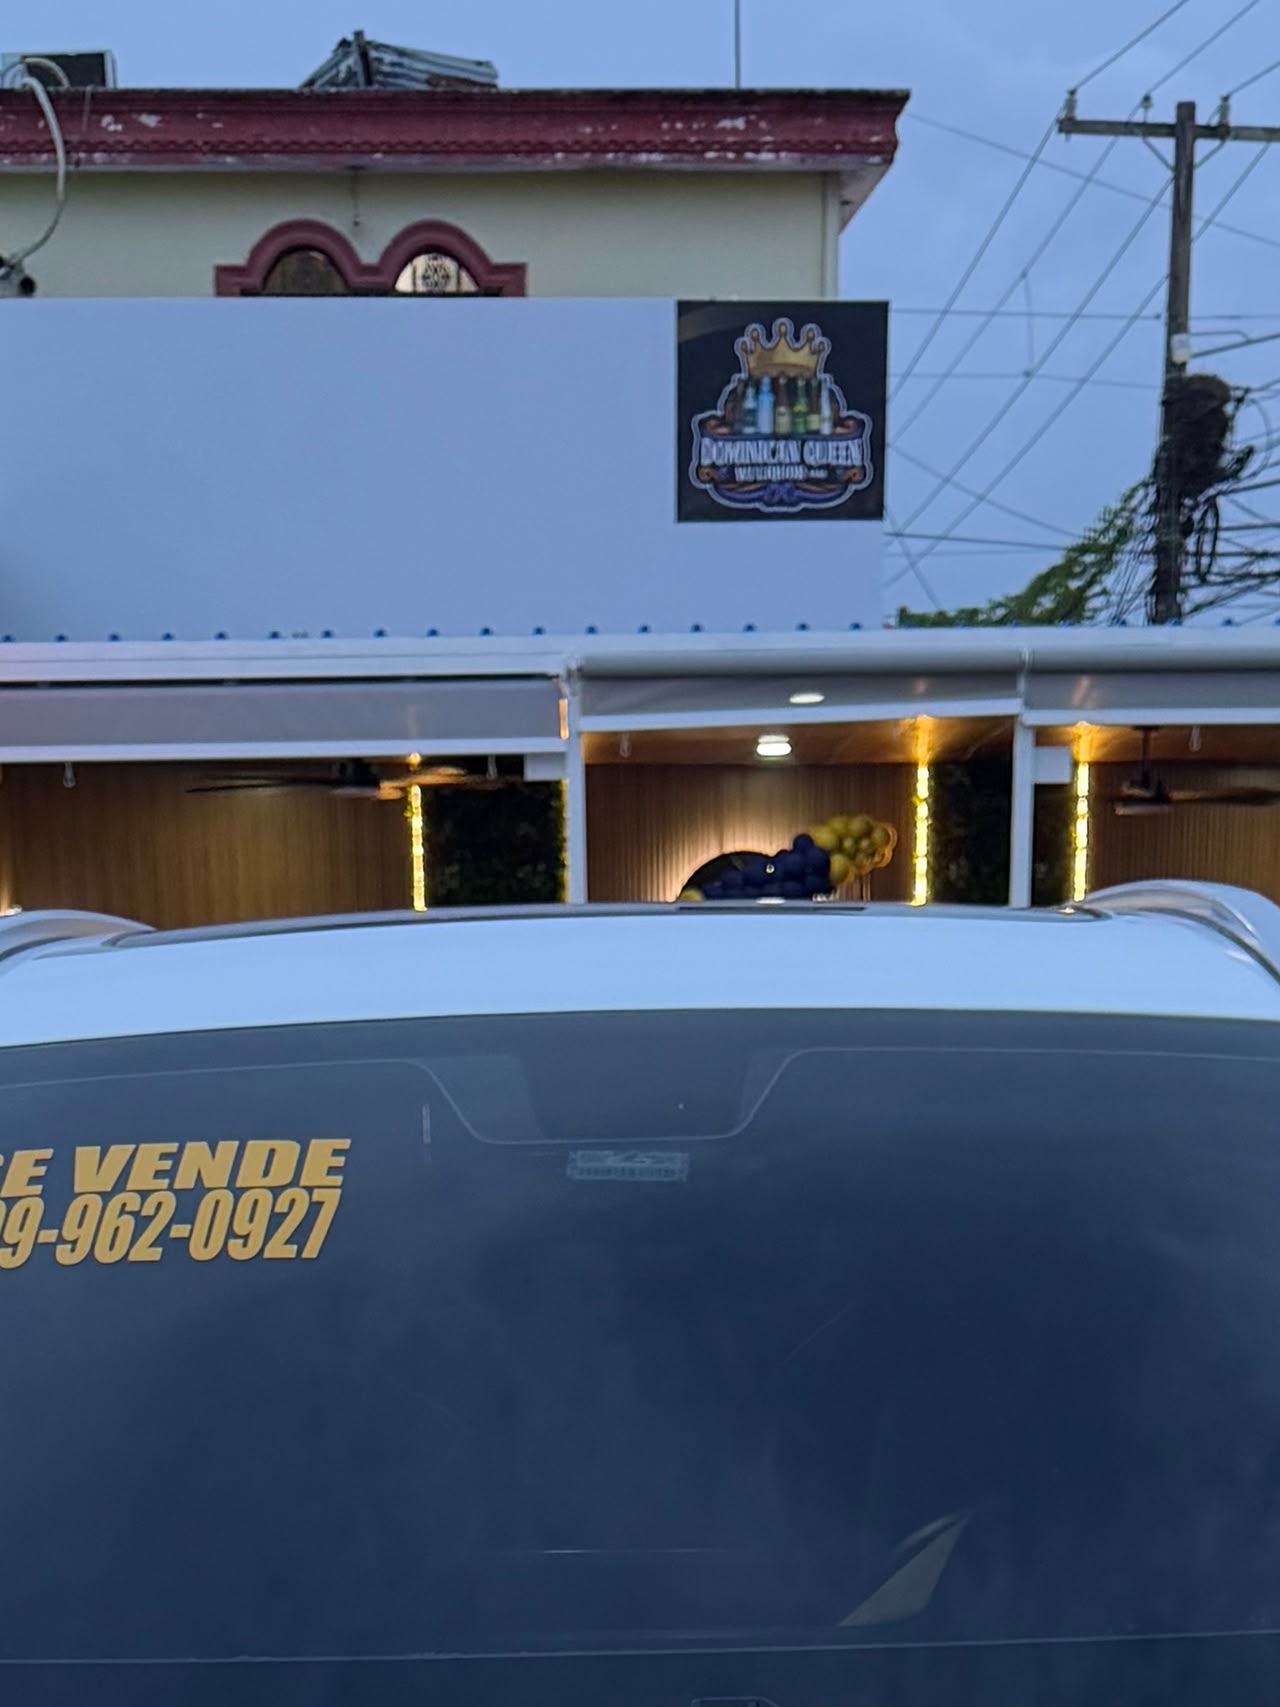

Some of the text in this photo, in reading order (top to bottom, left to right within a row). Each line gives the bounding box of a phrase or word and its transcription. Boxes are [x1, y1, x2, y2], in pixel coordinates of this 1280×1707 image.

[701, 437, 863, 466] DOMINICAN QUEEN
[73, 1138, 352, 1193] VENDE
